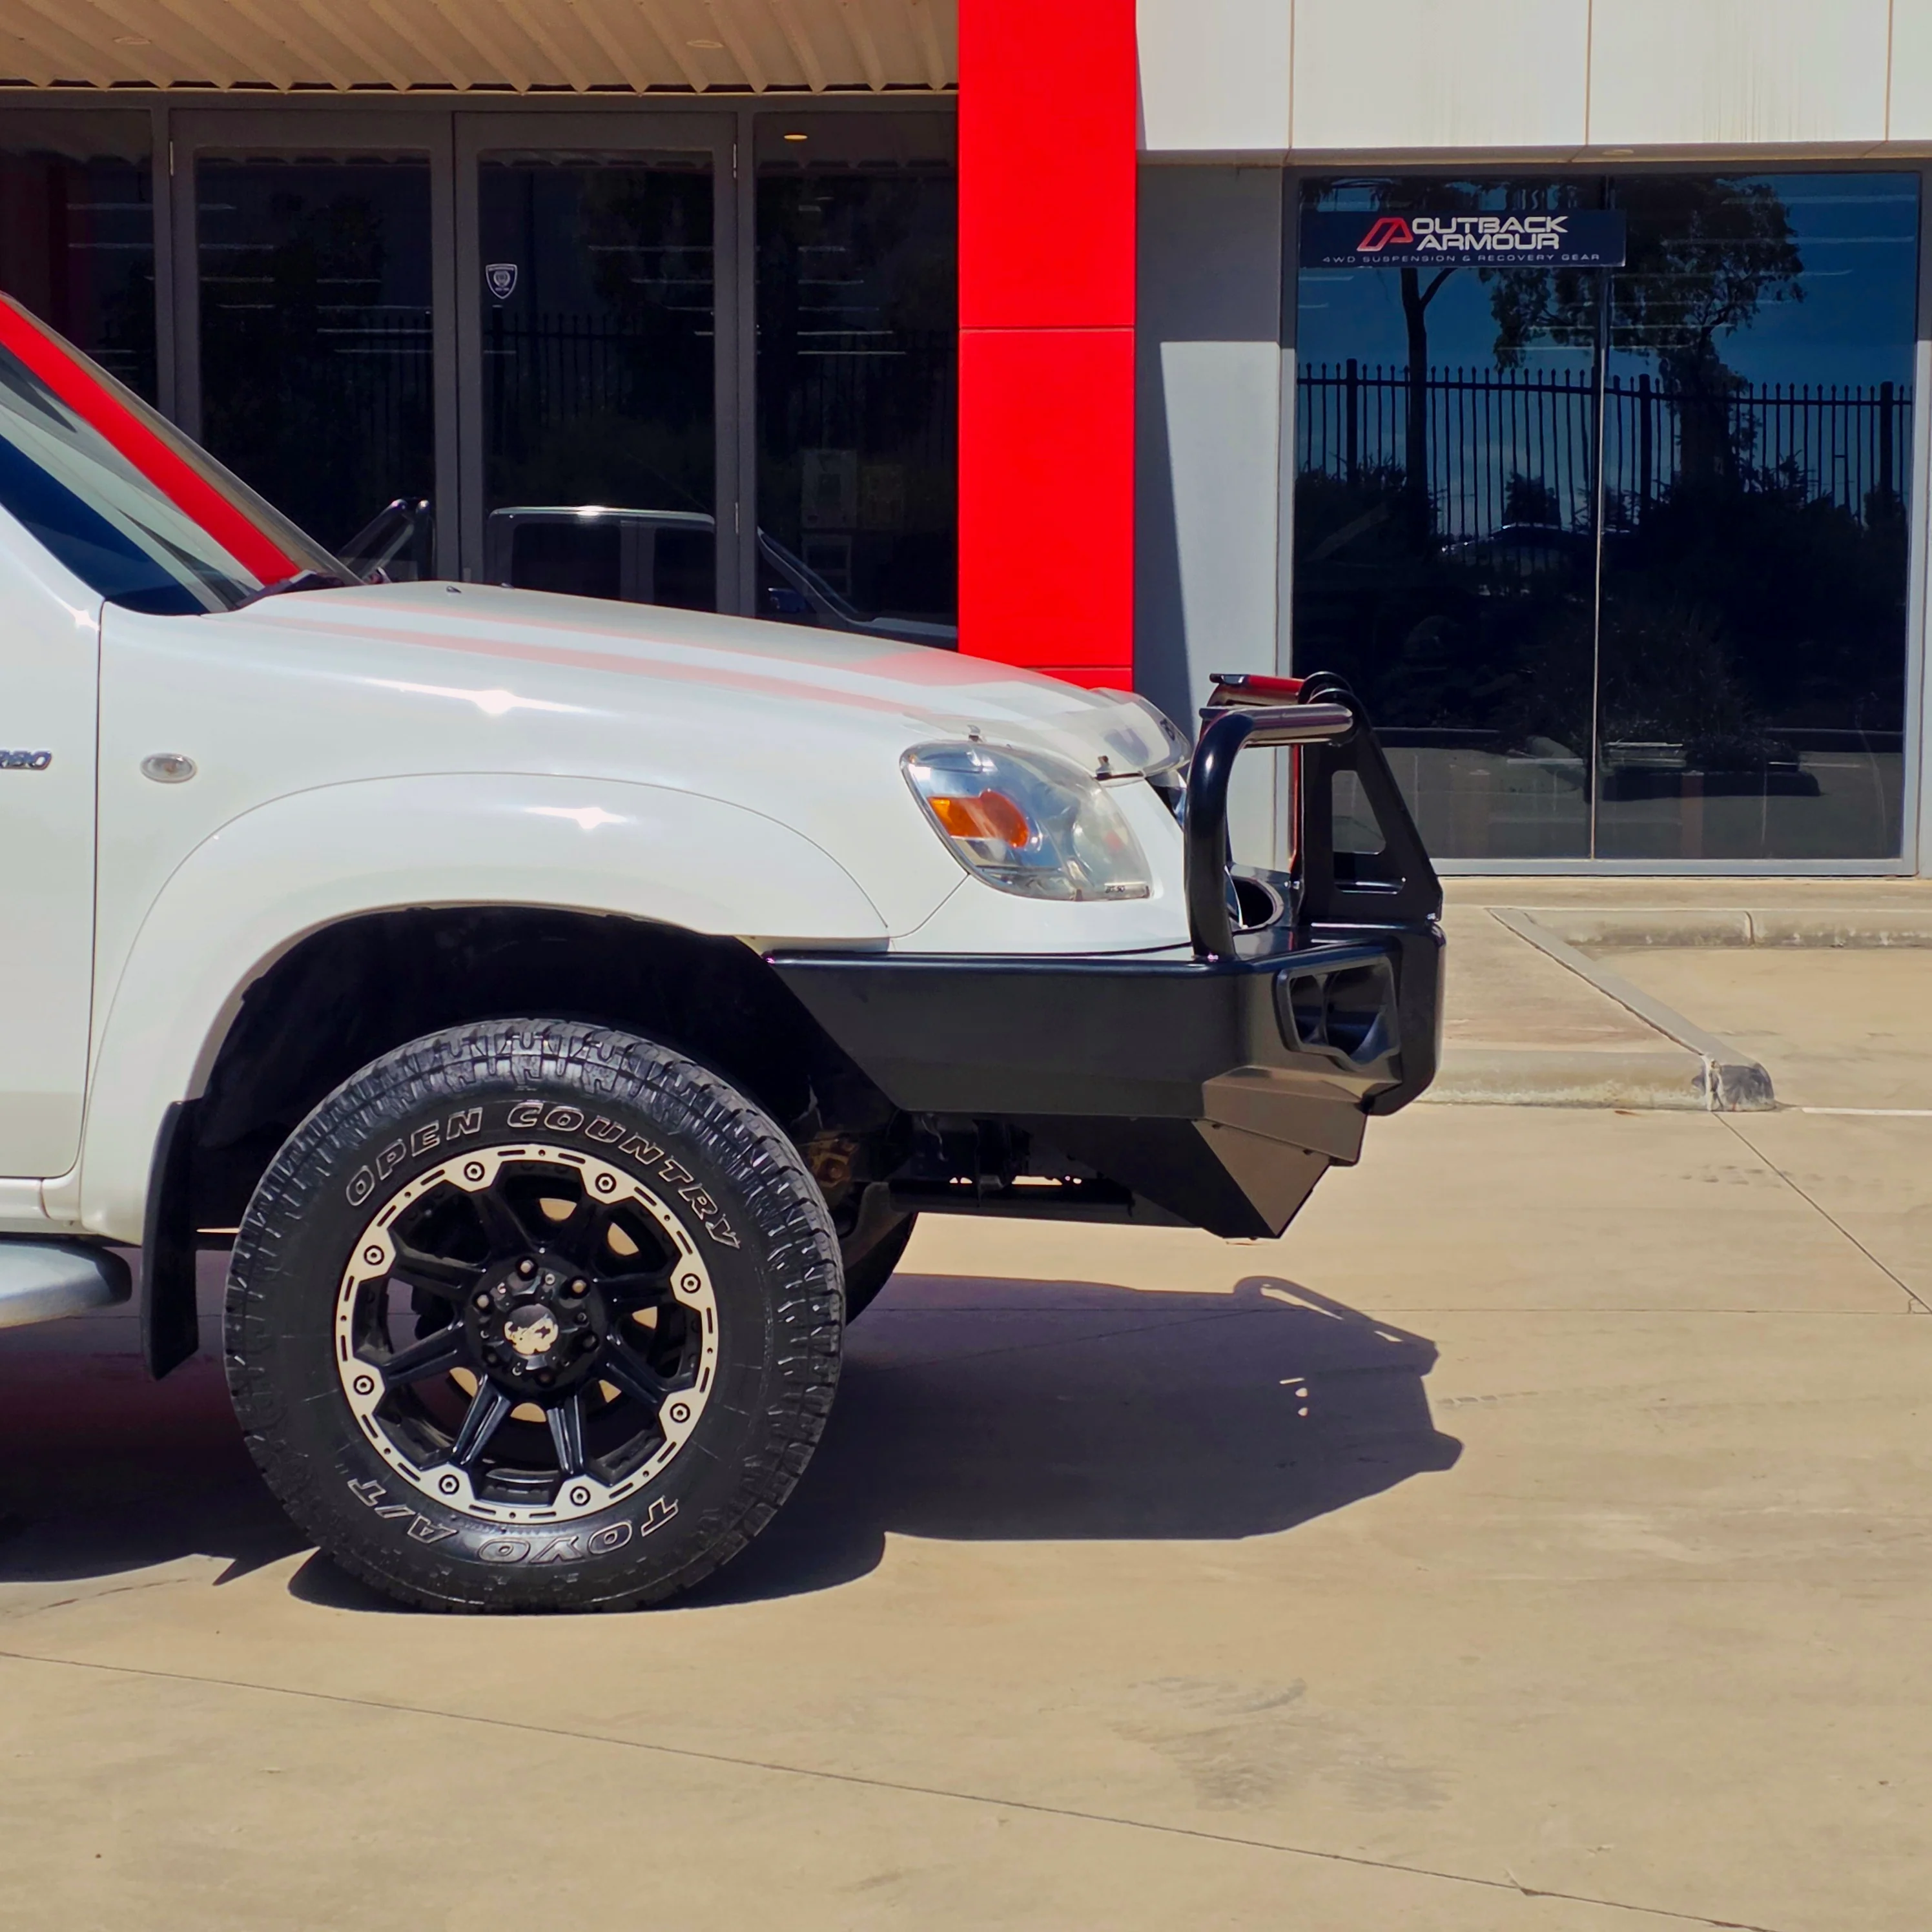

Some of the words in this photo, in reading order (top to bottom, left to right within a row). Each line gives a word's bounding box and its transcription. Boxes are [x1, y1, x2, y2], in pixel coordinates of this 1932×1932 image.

[1412, 216, 1569, 234] OUTBACK
[1416, 233, 1560, 251] ARMOUR
[1362, 254, 1457, 263] SUSPENSION
[1477, 254, 1555, 262] RECOVERY
[345, 1107, 484, 1206] OPEN
[507, 1102, 741, 1249] COUNTRY
[347, 1479, 458, 1544] A/T
[478, 1495, 679, 1564] TOYO
